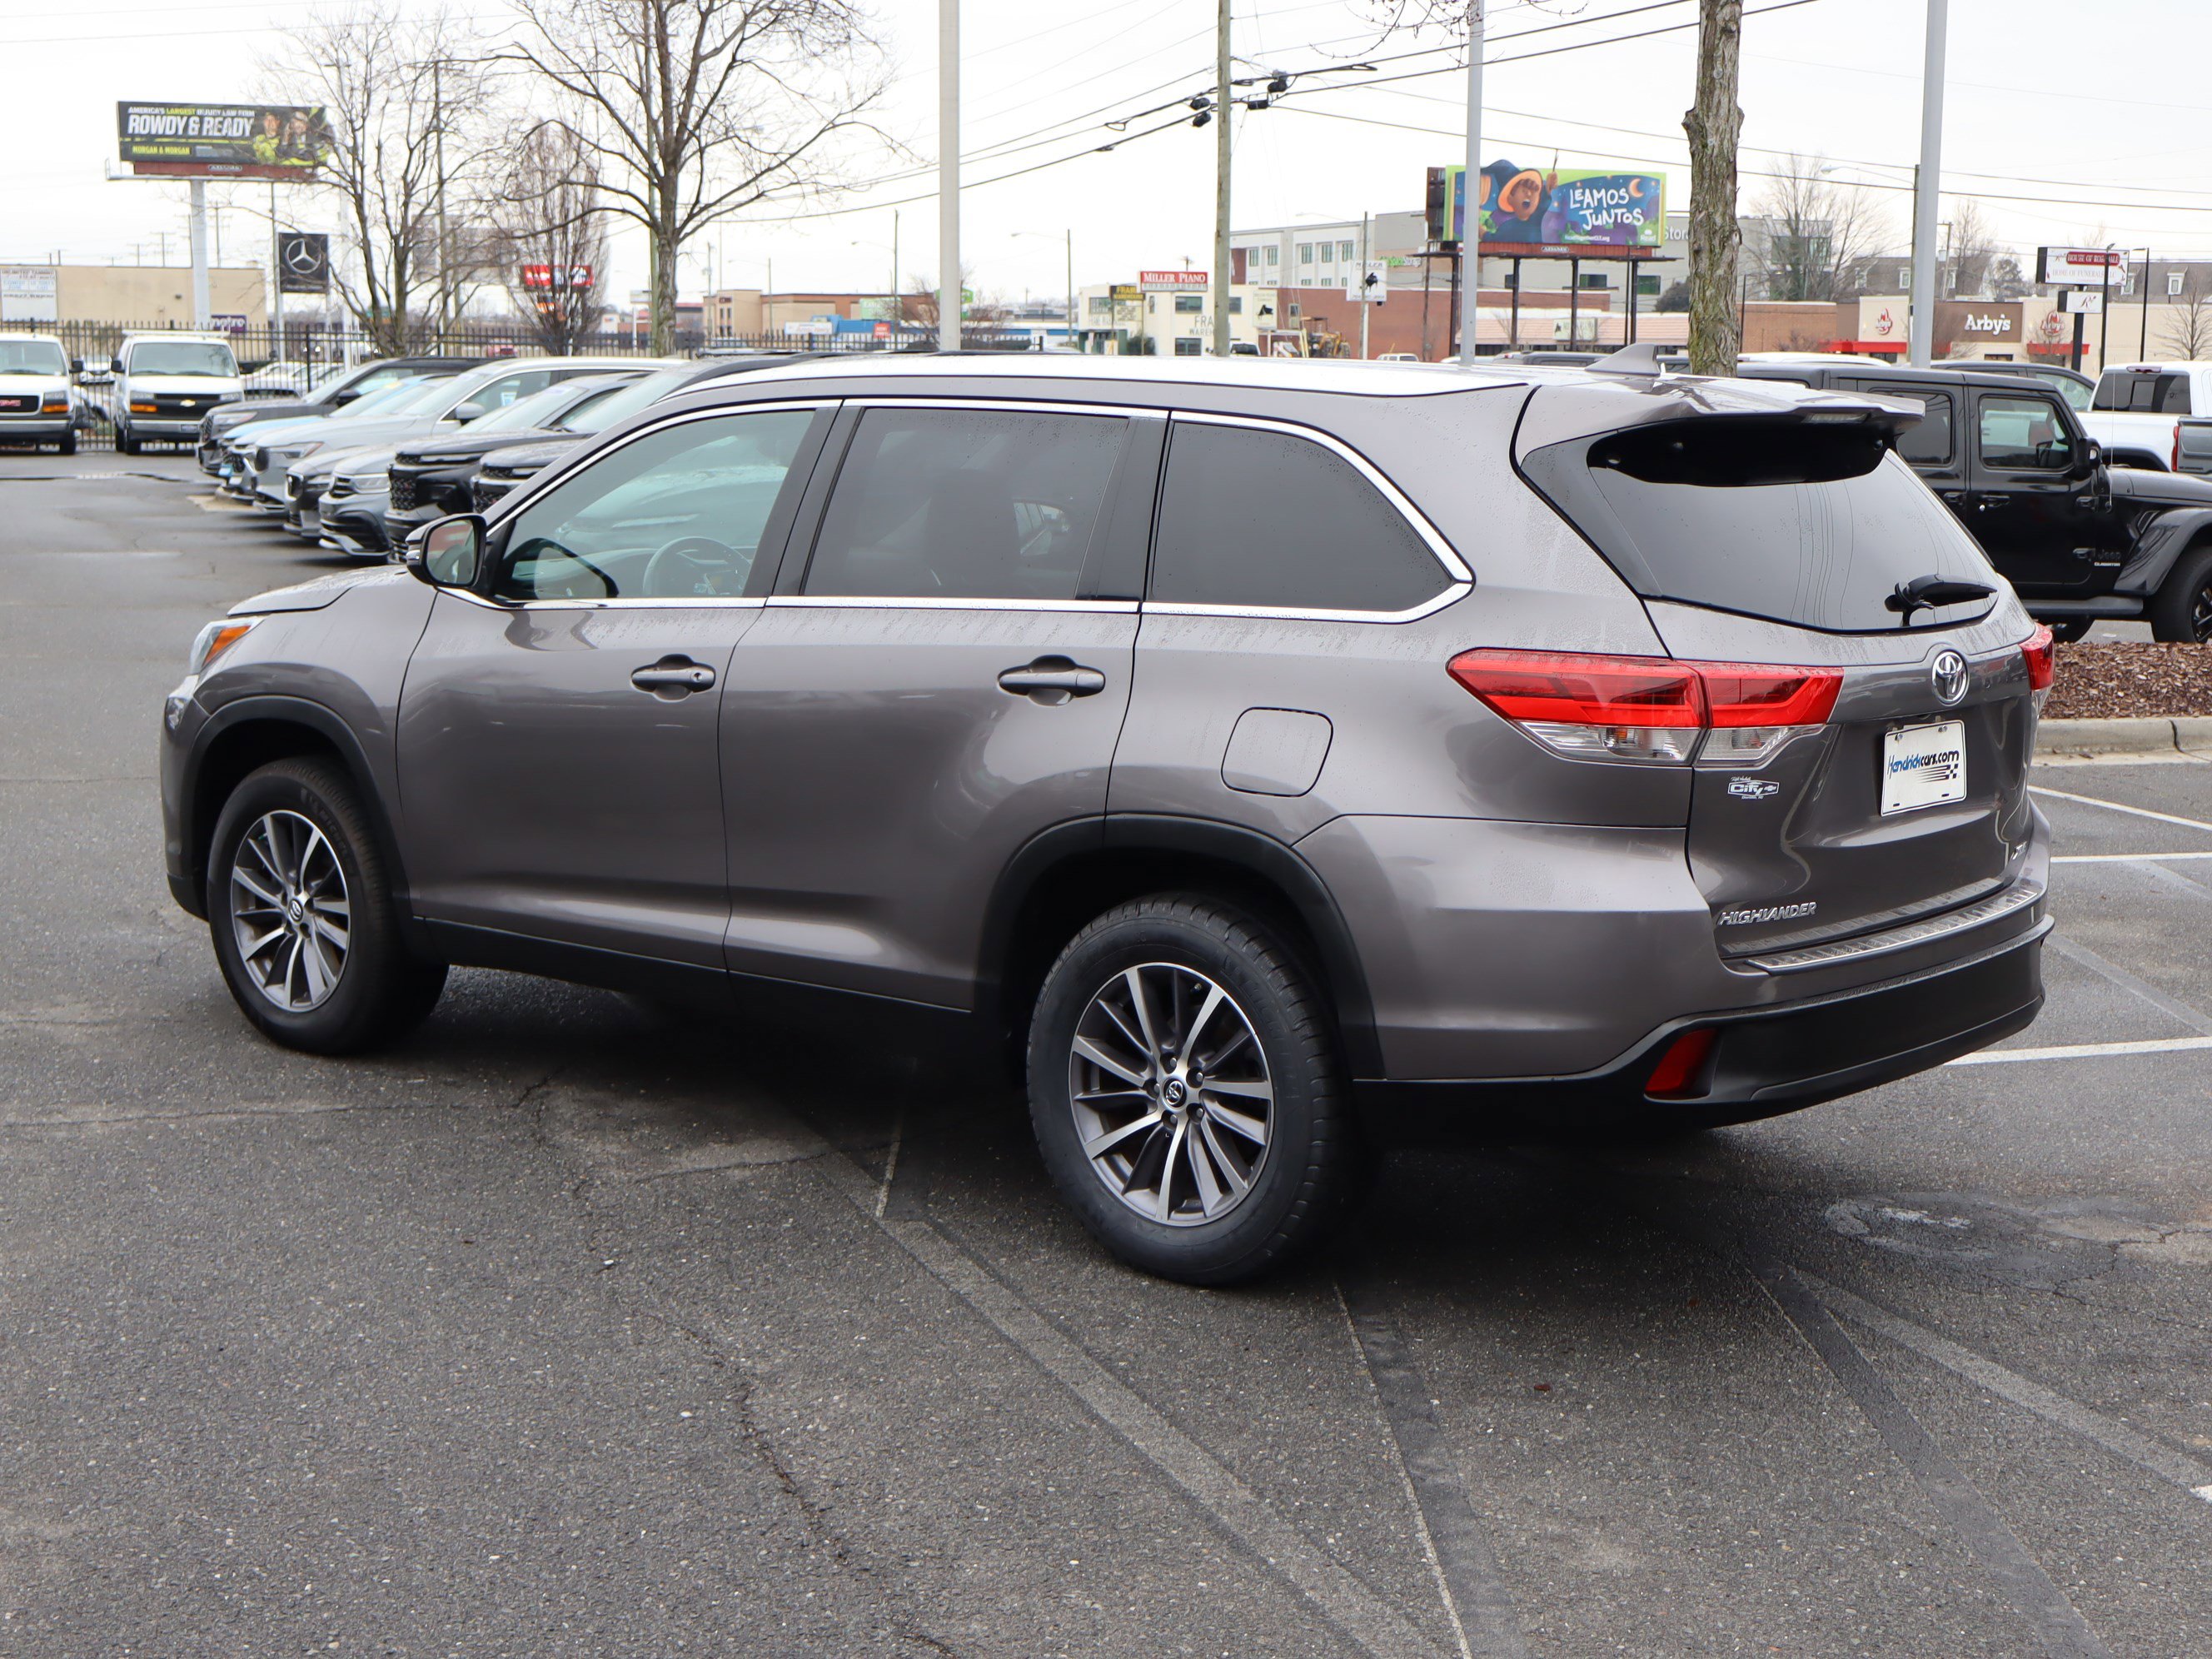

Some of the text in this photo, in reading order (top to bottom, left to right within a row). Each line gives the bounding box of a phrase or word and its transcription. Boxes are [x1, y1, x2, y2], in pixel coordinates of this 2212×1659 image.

[127, 106, 165, 115] AMERICA'S
[127, 114, 255, 137] ROWDY & READY
[132, 146, 158, 155] MORGAN
[165, 147, 192, 156] MORGAN
[1569, 187, 1630, 209] LEAMOS
[1578, 207, 1645, 231] JUNTOS
[2085, 254, 2093, 263] OF
[1143, 272, 1206, 283] MILLER PIANO
[1194, 316, 1214, 327] FRA
[1964, 313, 2011, 336] Arby's
[1886, 750, 1960, 780] Hendrickcars.com
[1730, 782, 1764, 796] City
[1716, 901, 1817, 926] HIGHLANDER
